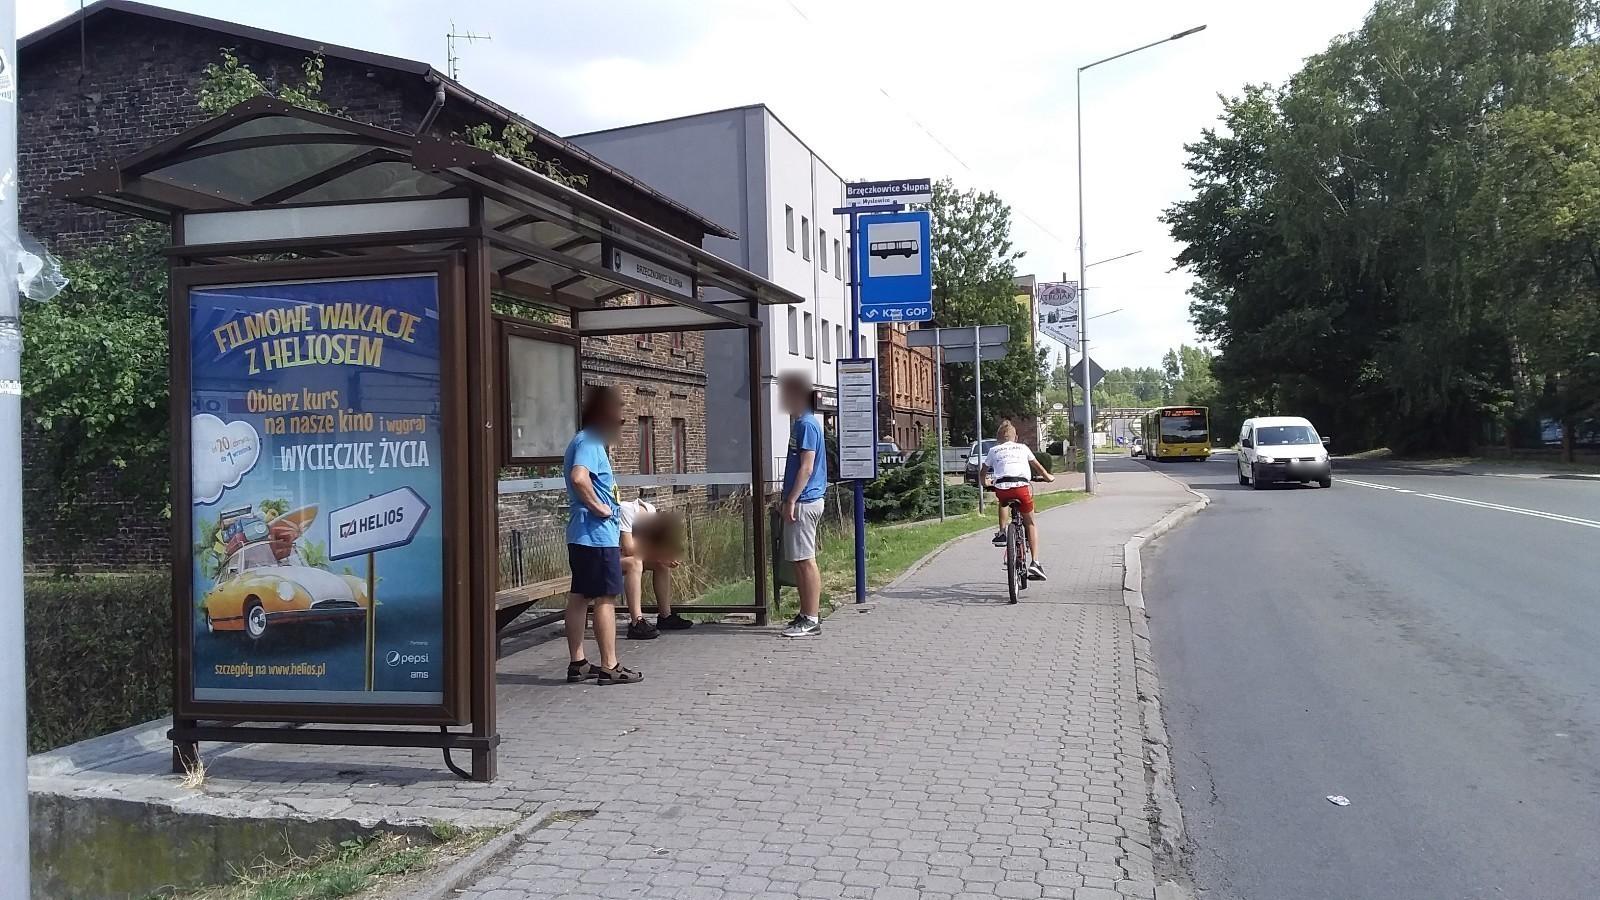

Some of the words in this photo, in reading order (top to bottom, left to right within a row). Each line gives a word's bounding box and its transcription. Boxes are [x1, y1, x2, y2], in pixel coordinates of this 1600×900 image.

[847, 184, 900, 196] Brzęczkowice
[901, 183, 929, 193] Słupna
[905, 307, 928, 316] GOP
[212, 305, 313, 354] FILMOWE
[319, 302, 422, 344] WAKACJE
[244, 348, 260, 376] Z
[263, 334, 384, 371] HELIOSEM
[247, 388, 300, 413] Obierz
[303, 387, 339, 410] kurs
[264, 416, 286, 434] na
[290, 415, 334, 434] nasze
[338, 409, 373, 432] kino
[379, 416, 384, 432] i
[386, 414, 426, 436] wygraj
[280, 443, 374, 473] WYCIECZKĘ
[378, 437, 430, 468] ŻYCIA
[359, 506, 404, 533] HELIOS
[214, 663, 254, 678] szczegóły
[255, 665, 267, 675] na
[267, 662, 326, 677] www.helios.pl
[401, 653, 429, 665] pepsi
[410, 671, 429, 679] ams
